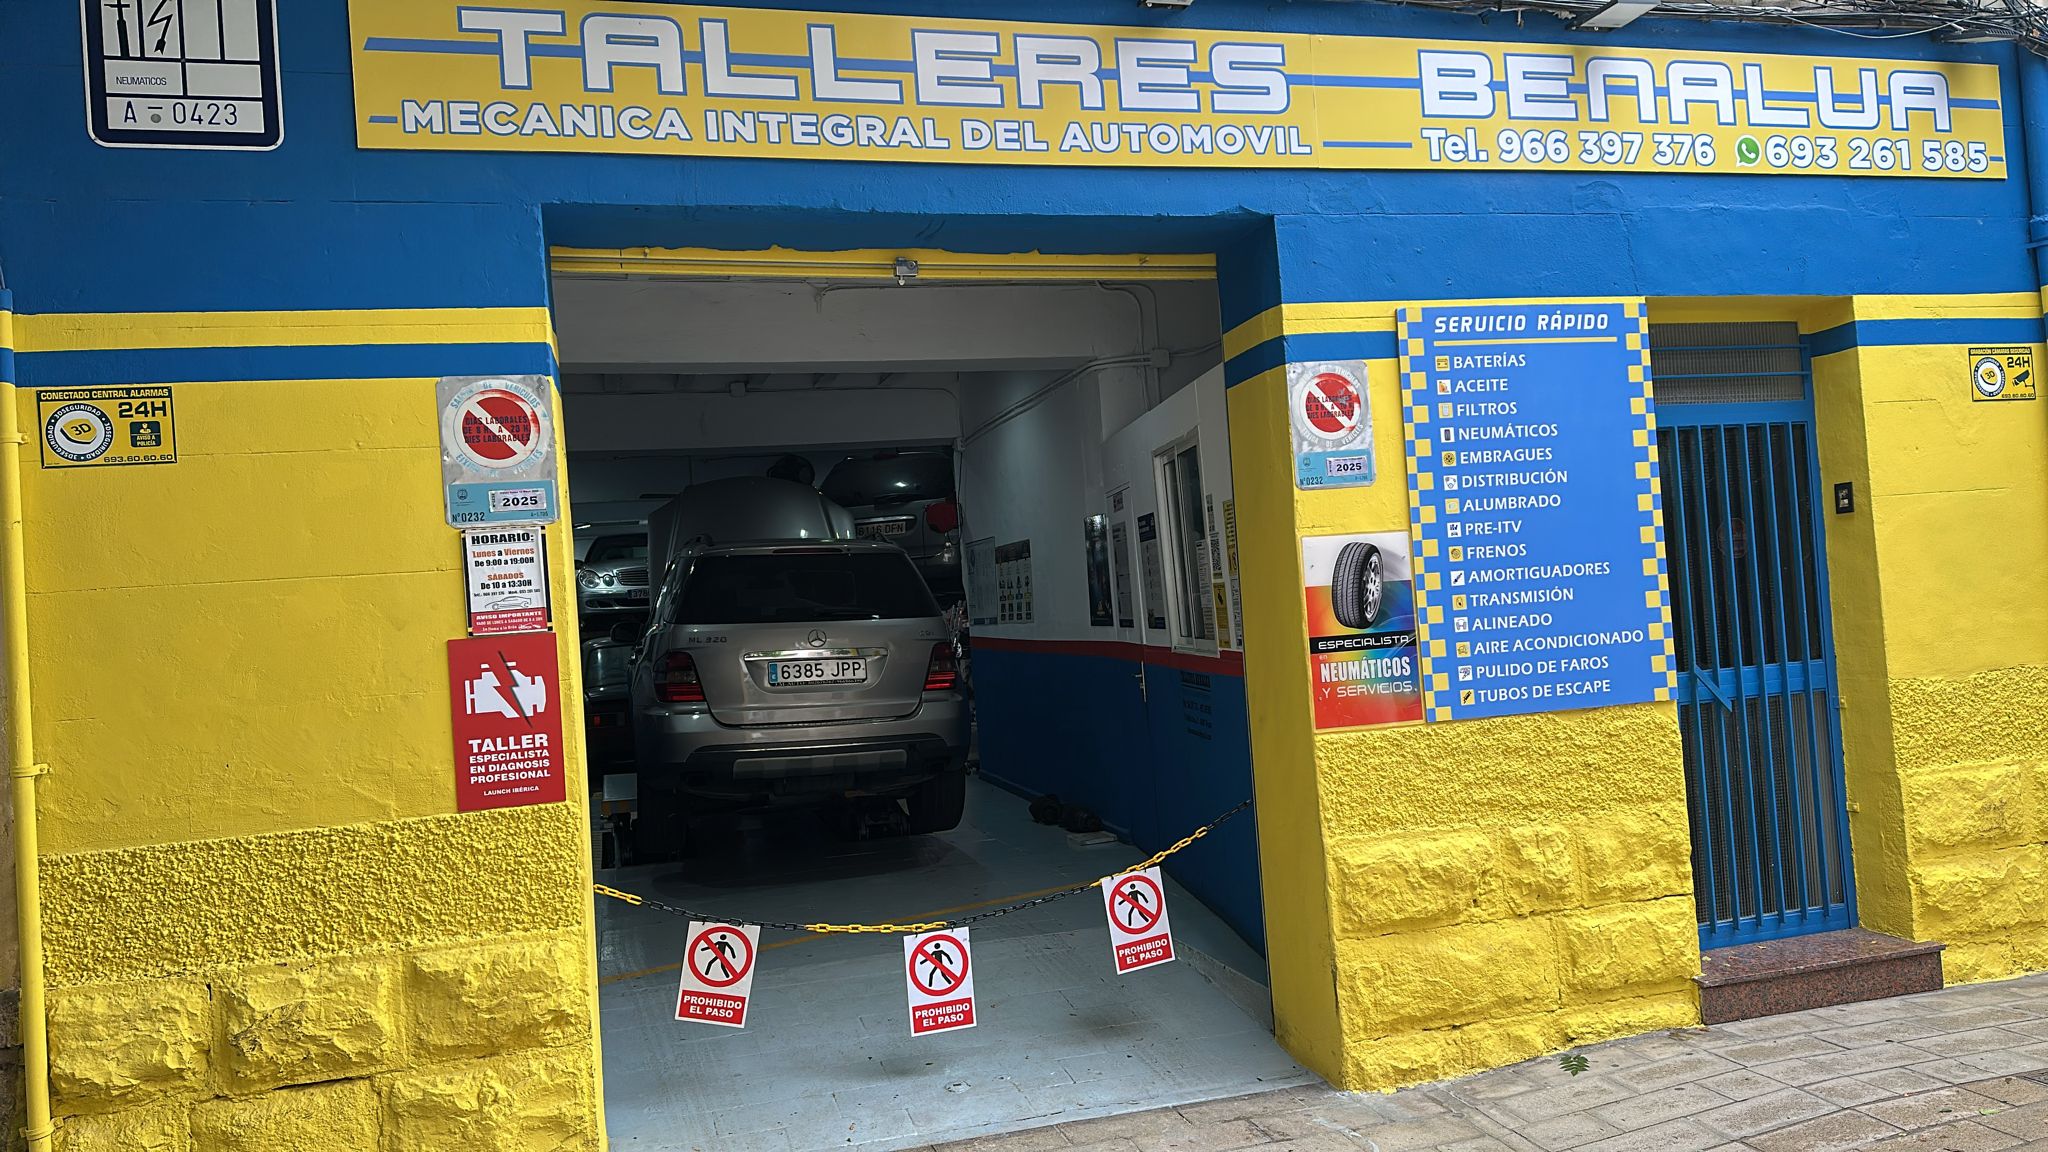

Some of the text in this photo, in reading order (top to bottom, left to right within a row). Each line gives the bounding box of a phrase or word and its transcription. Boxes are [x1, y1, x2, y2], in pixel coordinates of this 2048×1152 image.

[457, 6, 1952, 133] TALLERES BENALUA
[116, 77, 166, 86] NEUMATICOS
[124, 101, 136, 123] A
[173, 102, 238, 126] 0423
[402, 100, 1312, 155] MECANICA INTEGRAL DEL AUTOMOVIL
[1422, 128, 1988, 172] Tel. 966 397 376 693 261 585
[1434, 310, 1608, 333] SERVICIO RÁPIDO
[1453, 352, 1526, 369] BATERÍAS
[2007, 357, 2030, 368] 24H
[1985, 371, 1995, 379] 3D
[1455, 378, 1508, 393] ACEITE
[41, 388, 168, 400] CONECTADO CENTRAL ALARMAS
[54, 404, 101, 420] 3DSEGURIDAD
[118, 401, 167, 418] 24H
[1457, 402, 1517, 416] FILTROS
[485, 416, 528, 424] LABORALES
[71, 423, 91, 436] 3D
[1458, 422, 1558, 440] NEUMÁTICOS
[104, 454, 172, 463] 693.60.60.60
[1460, 448, 1552, 464] EMBRAGUES
[1336, 463, 1362, 472] 2025
[1462, 468, 1568, 488] DISTRIBUCIÓN
[502, 496, 538, 506] 2025
[1464, 494, 1561, 512] ALUMBRADO
[1465, 521, 1522, 536] PRE-ITV
[471, 533, 534, 544] HORARIO:
[504, 548, 534, 556] Viernes
[1467, 544, 1526, 559] FRENOS
[488, 572, 524, 581] SÁBADOS
[1468, 562, 1610, 583] AMORTIGUADORES
[1471, 586, 1574, 606] TRANSMISIÓN
[1472, 614, 1552, 630] ALINEADO
[1318, 635, 1408, 650] ESPECIALISTA
[1474, 630, 1644, 654] AIRE ACONDICIONADO
[782, 662, 861, 679] 6385 JPP
[1320, 656, 1411, 682] NEUMÁTICOS
[1477, 656, 1608, 678] PULIDO DE FAROS
[1322, 688, 1330, 698] Y
[1478, 680, 1611, 703] TUBOS DE ESCAPE
[468, 734, 548, 753] TALLER
[470, 750, 549, 764] ESPECIALISTA
[470, 760, 550, 774] EN DIAGNOSIS
[470, 770, 550, 784] PROFESIONAL
[484, 788, 510, 796] LAUNCH
[1119, 939, 1167, 957] PROHIBIDO
[1126, 949, 1163, 964] EL PASO
[684, 996, 742, 1009] PROHIBIDO
[690, 1006, 733, 1017] EL PASO
[915, 1003, 970, 1019] PROHIBIDO
[923, 1014, 964, 1027] EL PASO
